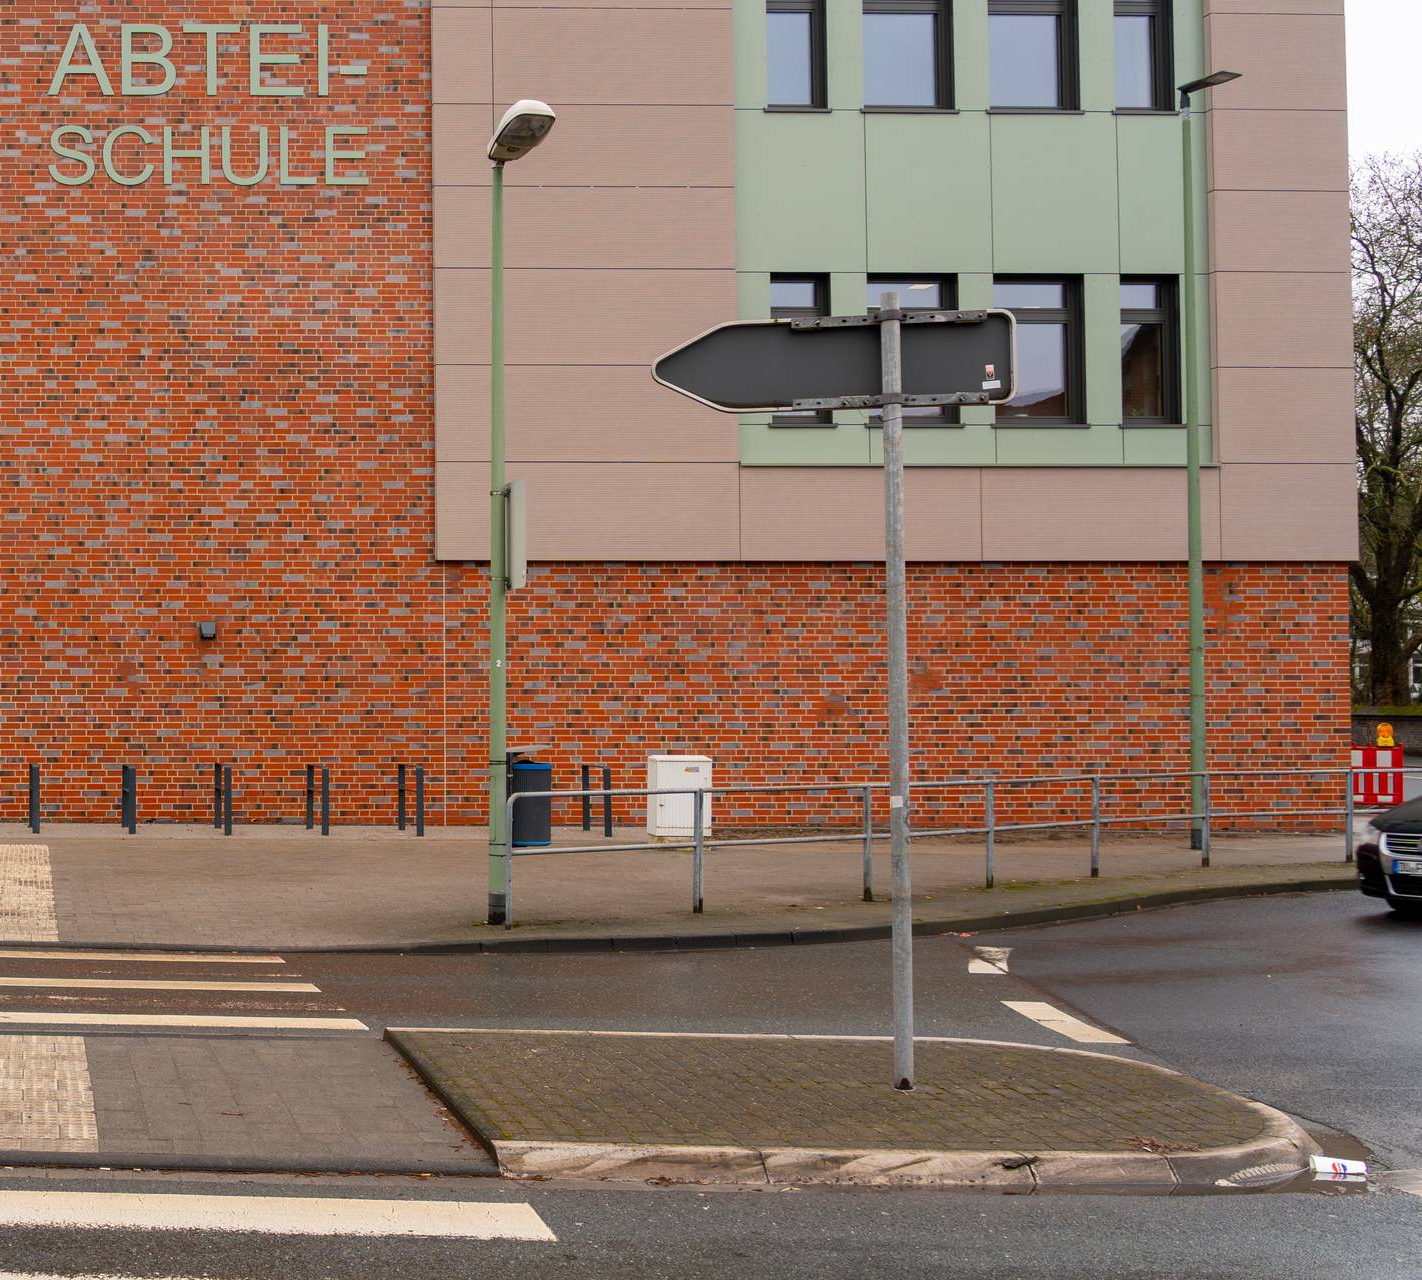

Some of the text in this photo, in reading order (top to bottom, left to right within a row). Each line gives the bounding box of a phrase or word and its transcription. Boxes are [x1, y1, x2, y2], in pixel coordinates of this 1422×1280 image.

[47, 23, 368, 97] ABTEI-
[48, 125, 370, 186] SCHULE
[495, 659, 503, 668] 2
